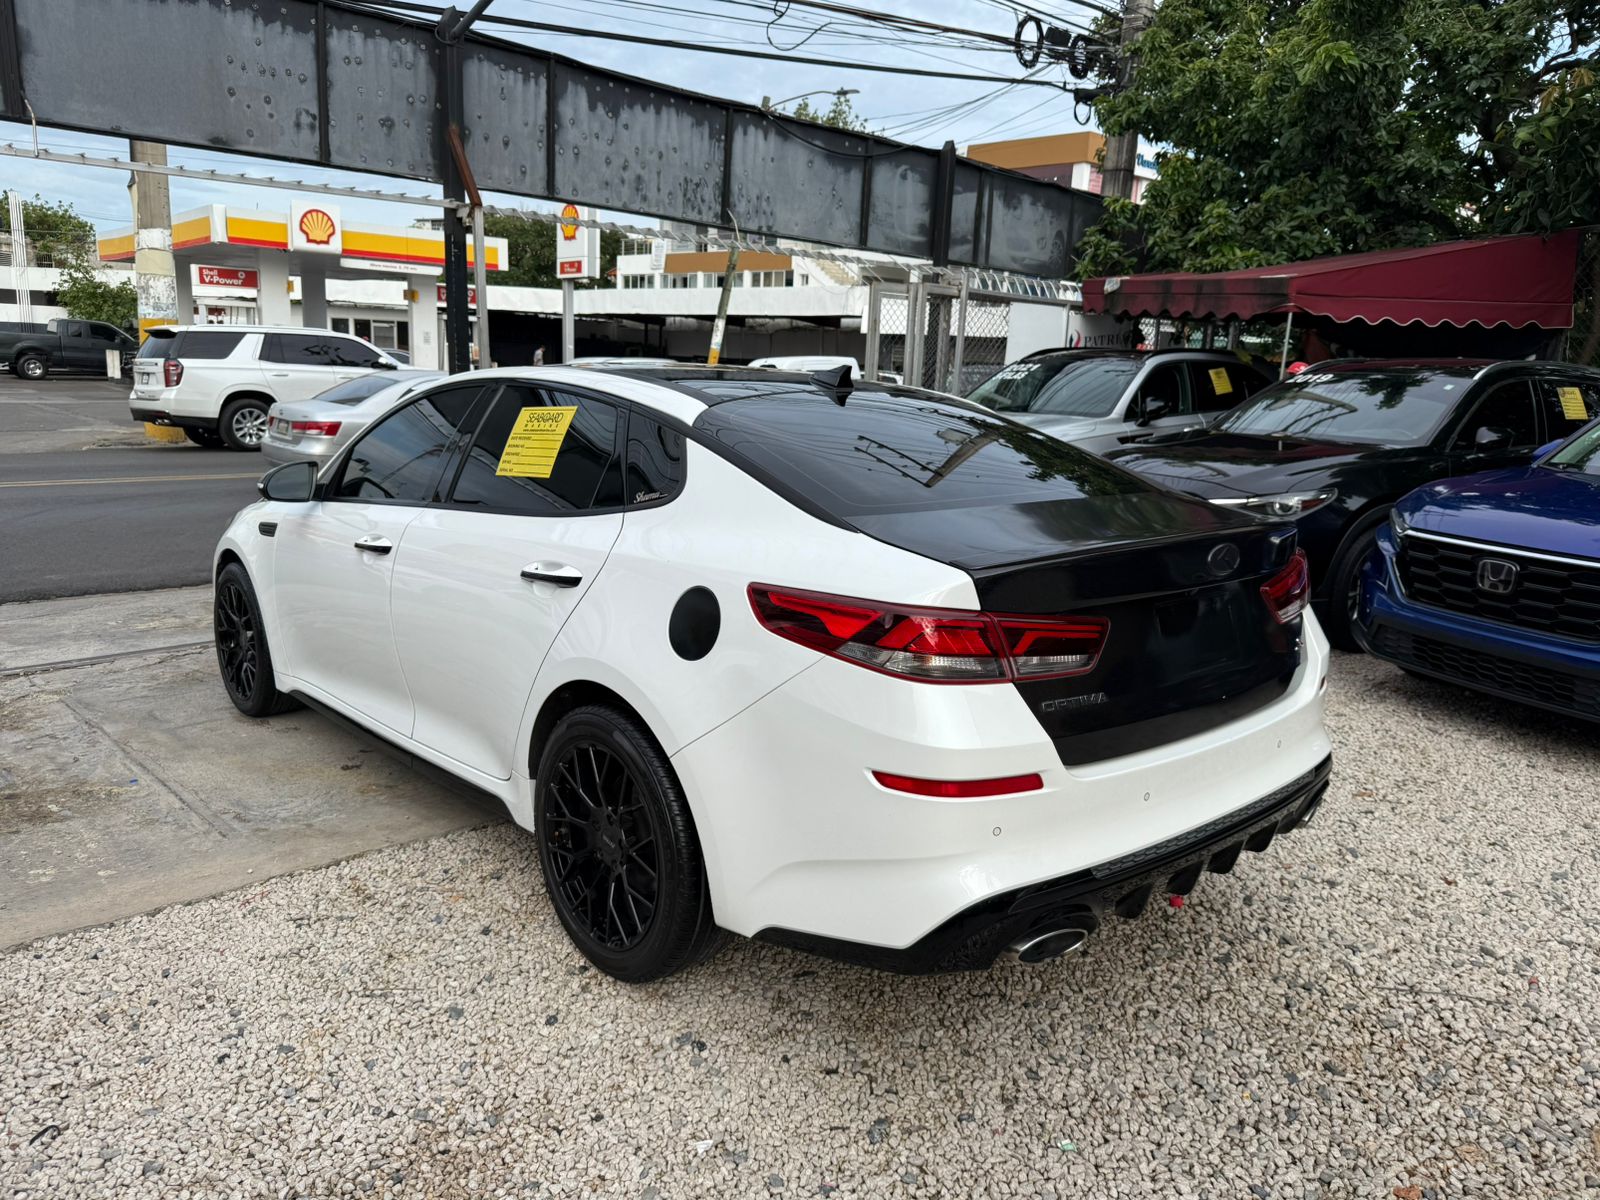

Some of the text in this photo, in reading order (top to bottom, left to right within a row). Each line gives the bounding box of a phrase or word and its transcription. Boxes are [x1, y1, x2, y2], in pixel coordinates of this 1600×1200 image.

[202, 268, 218, 276] Shell
[203, 275, 244, 285] V-Power
[1285, 373, 1335, 383] 2019
[526, 412, 564, 423] SEABOARD
[1041, 692, 1108, 712] OPTIMA
